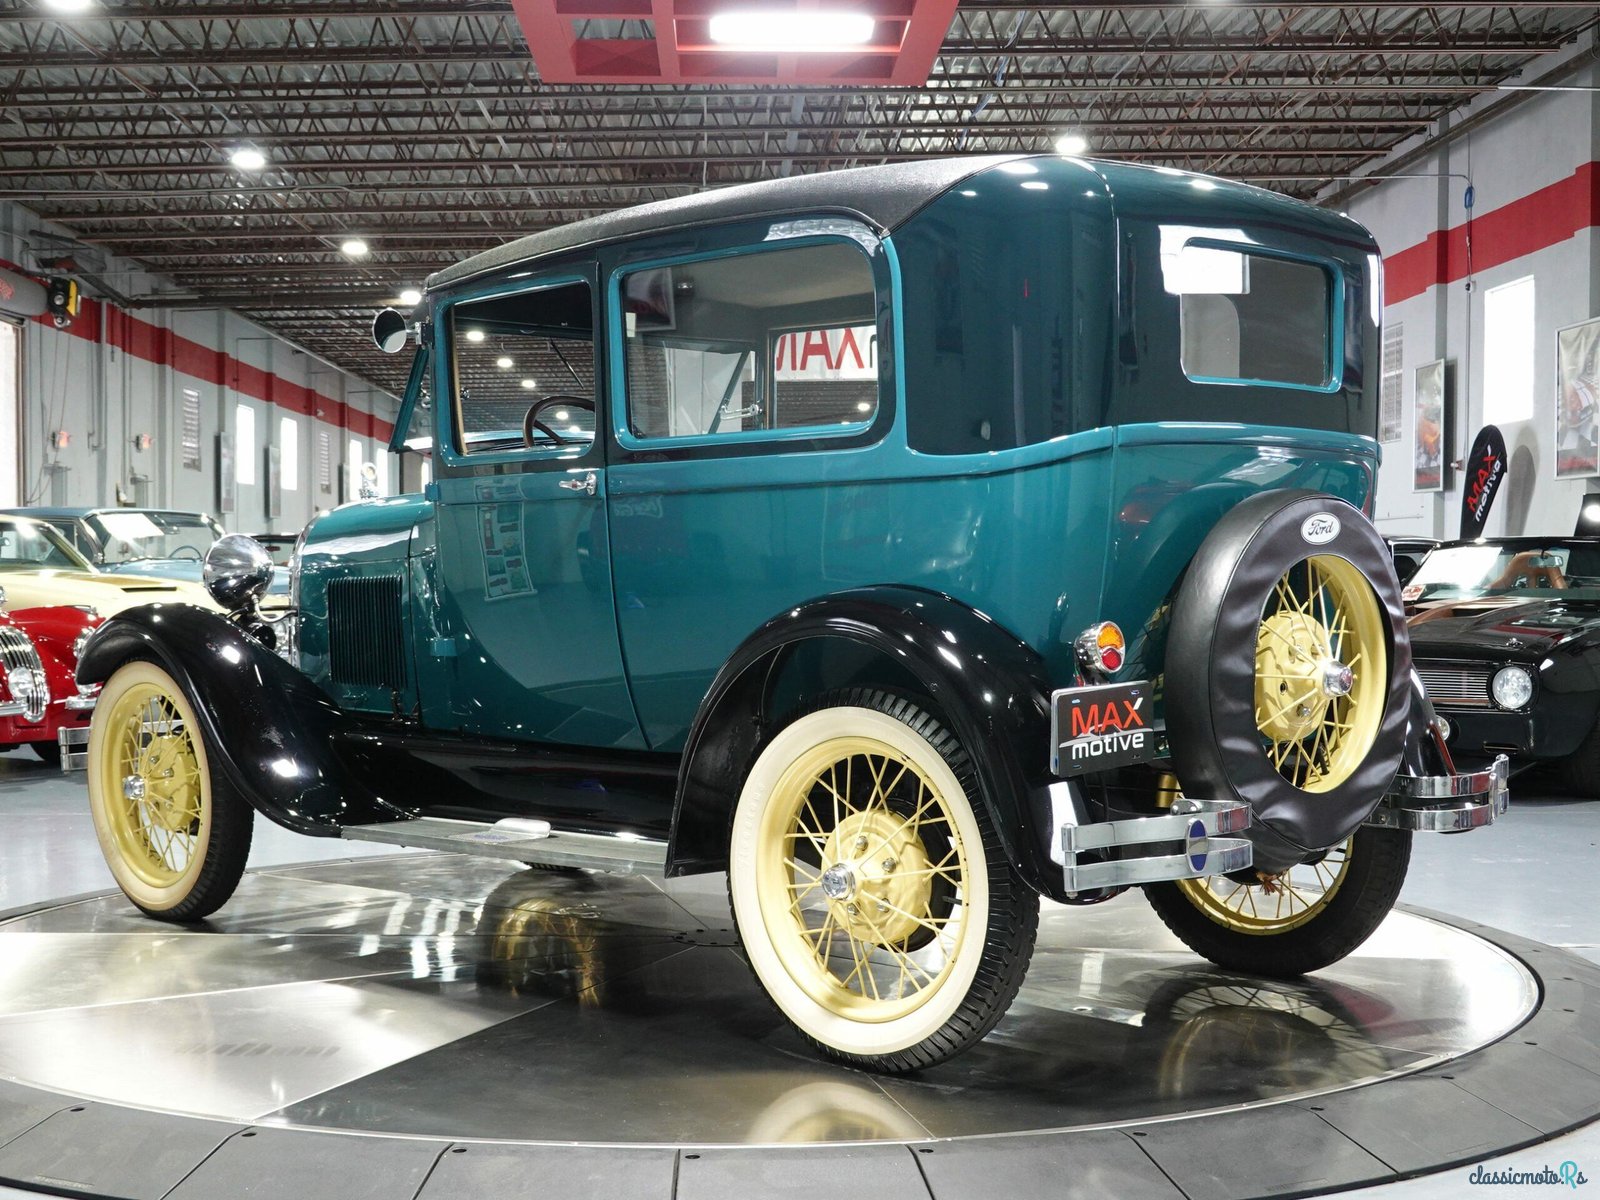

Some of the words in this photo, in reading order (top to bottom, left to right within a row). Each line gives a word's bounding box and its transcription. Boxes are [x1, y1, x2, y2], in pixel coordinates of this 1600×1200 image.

[1466, 444, 1498, 513] MAX
[1474, 459, 1502, 522] motive
[1307, 518, 1334, 536] Ford
[1071, 697, 1144, 737] MAX
[1071, 732, 1145, 760] motive
